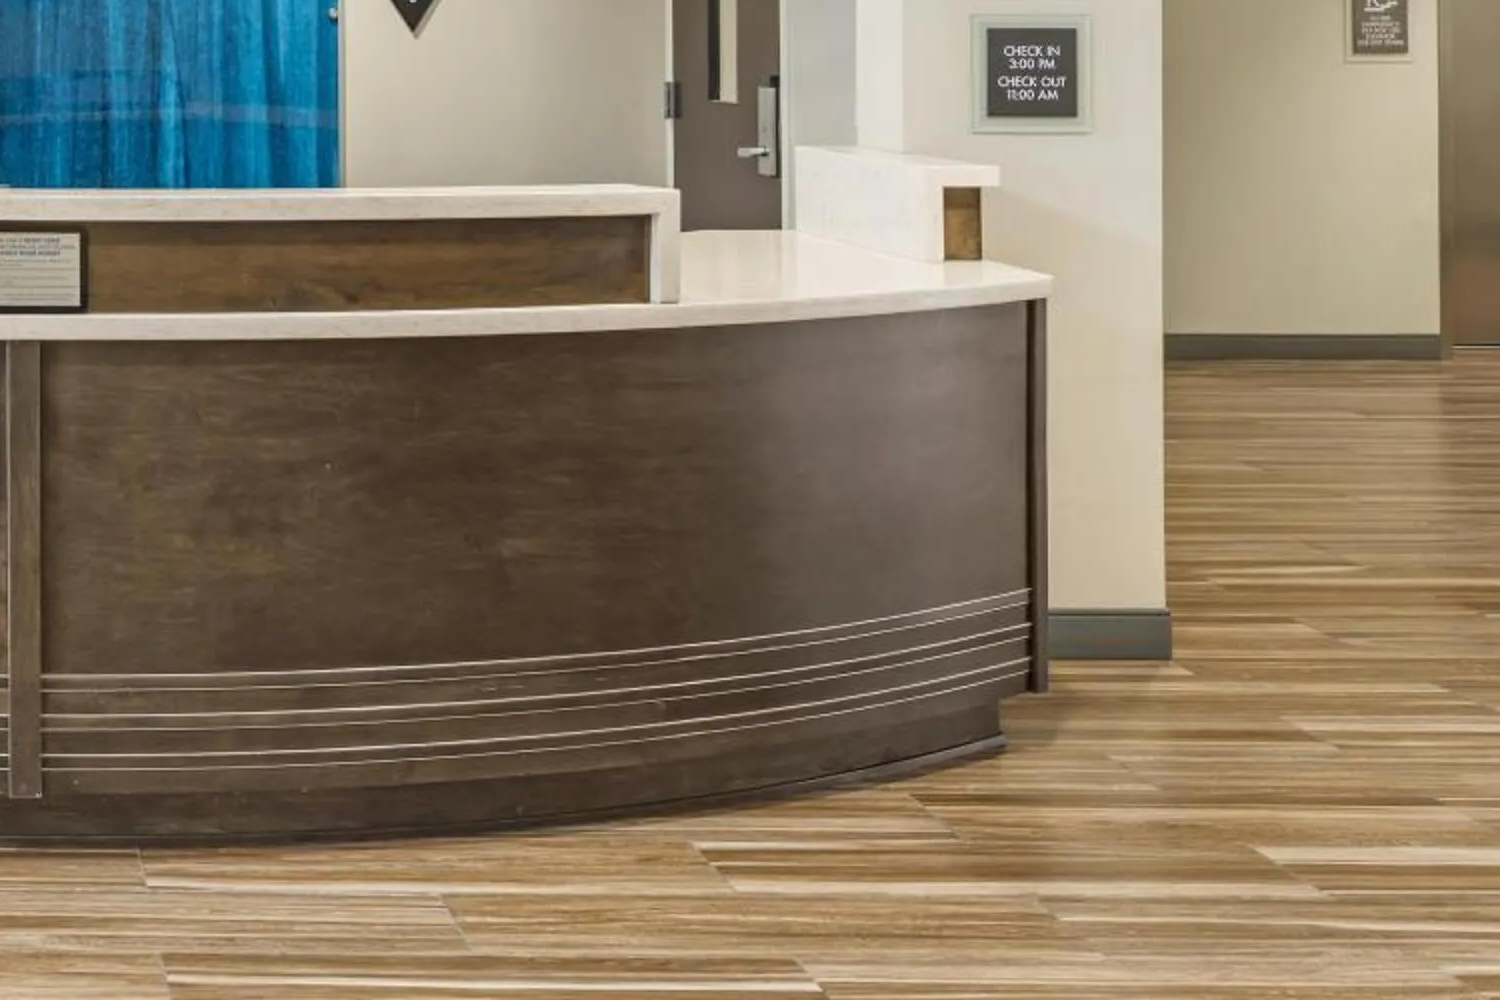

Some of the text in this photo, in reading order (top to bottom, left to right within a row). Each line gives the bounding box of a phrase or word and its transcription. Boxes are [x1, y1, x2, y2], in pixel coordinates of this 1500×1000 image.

[1003, 45, 1061, 57] CHECK IN
[1008, 58, 1056, 70] 3:00 PM
[997, 75, 1067, 88] CHECK OUT
[1007, 89, 1060, 101] 11:00 AM
